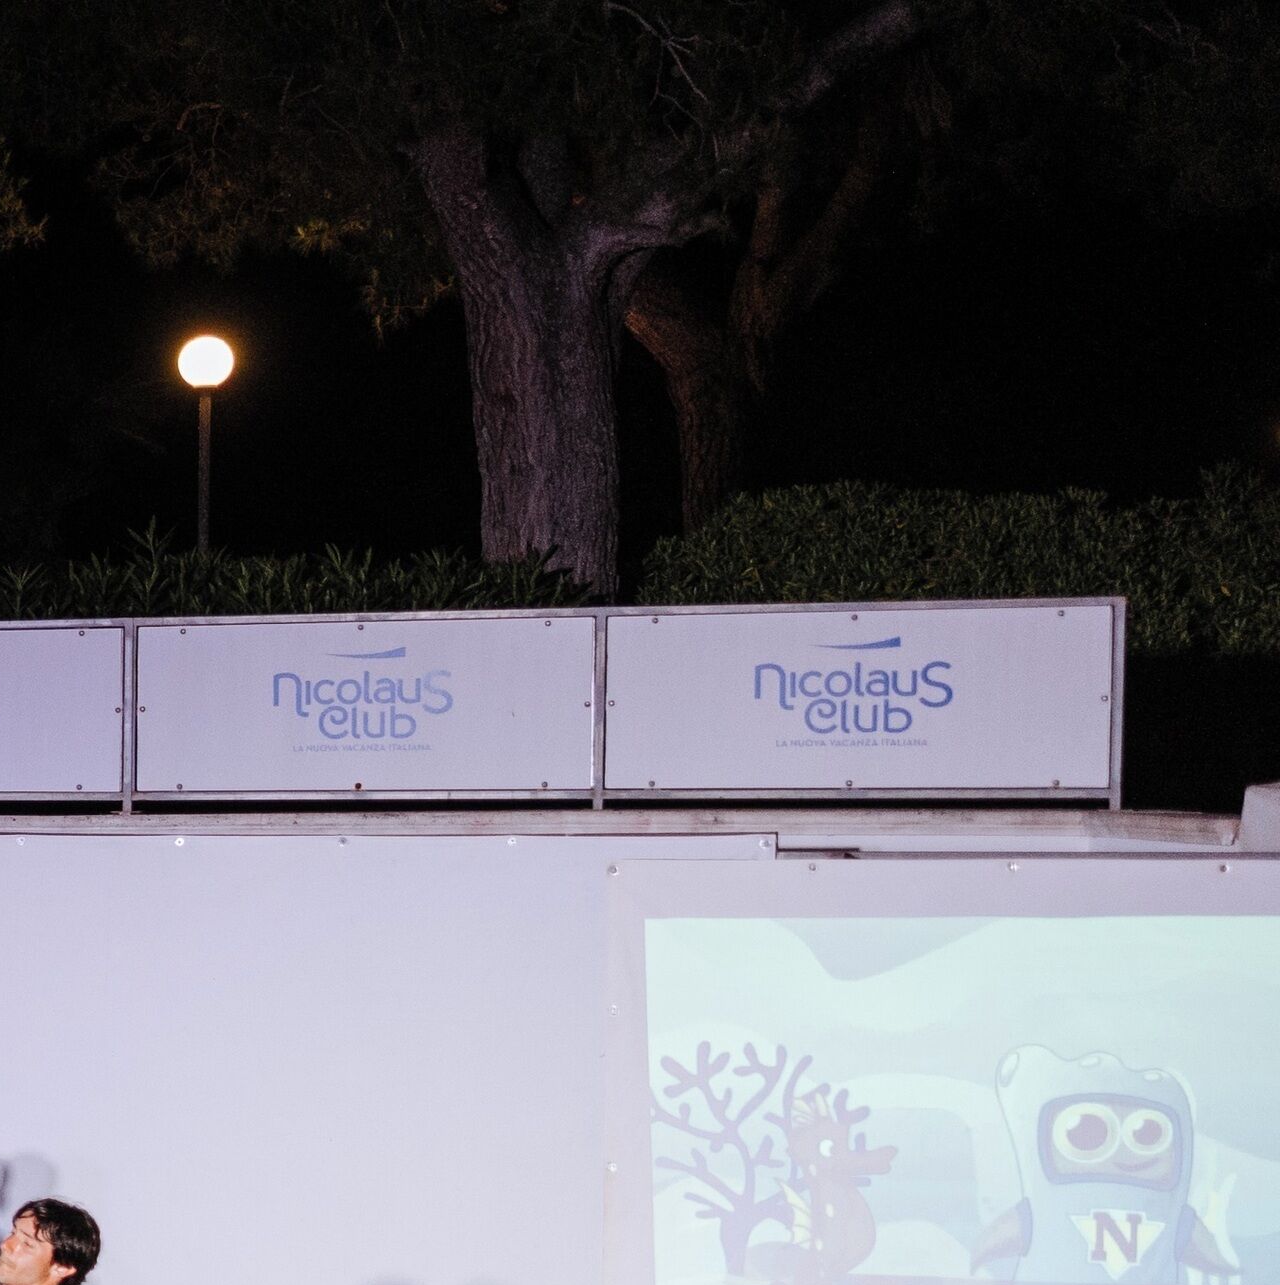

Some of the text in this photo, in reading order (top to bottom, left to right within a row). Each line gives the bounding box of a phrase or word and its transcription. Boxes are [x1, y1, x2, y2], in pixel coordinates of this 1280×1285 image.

[318, 705, 417, 739] Club
[804, 698, 913, 734] Club
[1090, 1211, 1142, 1263] N
